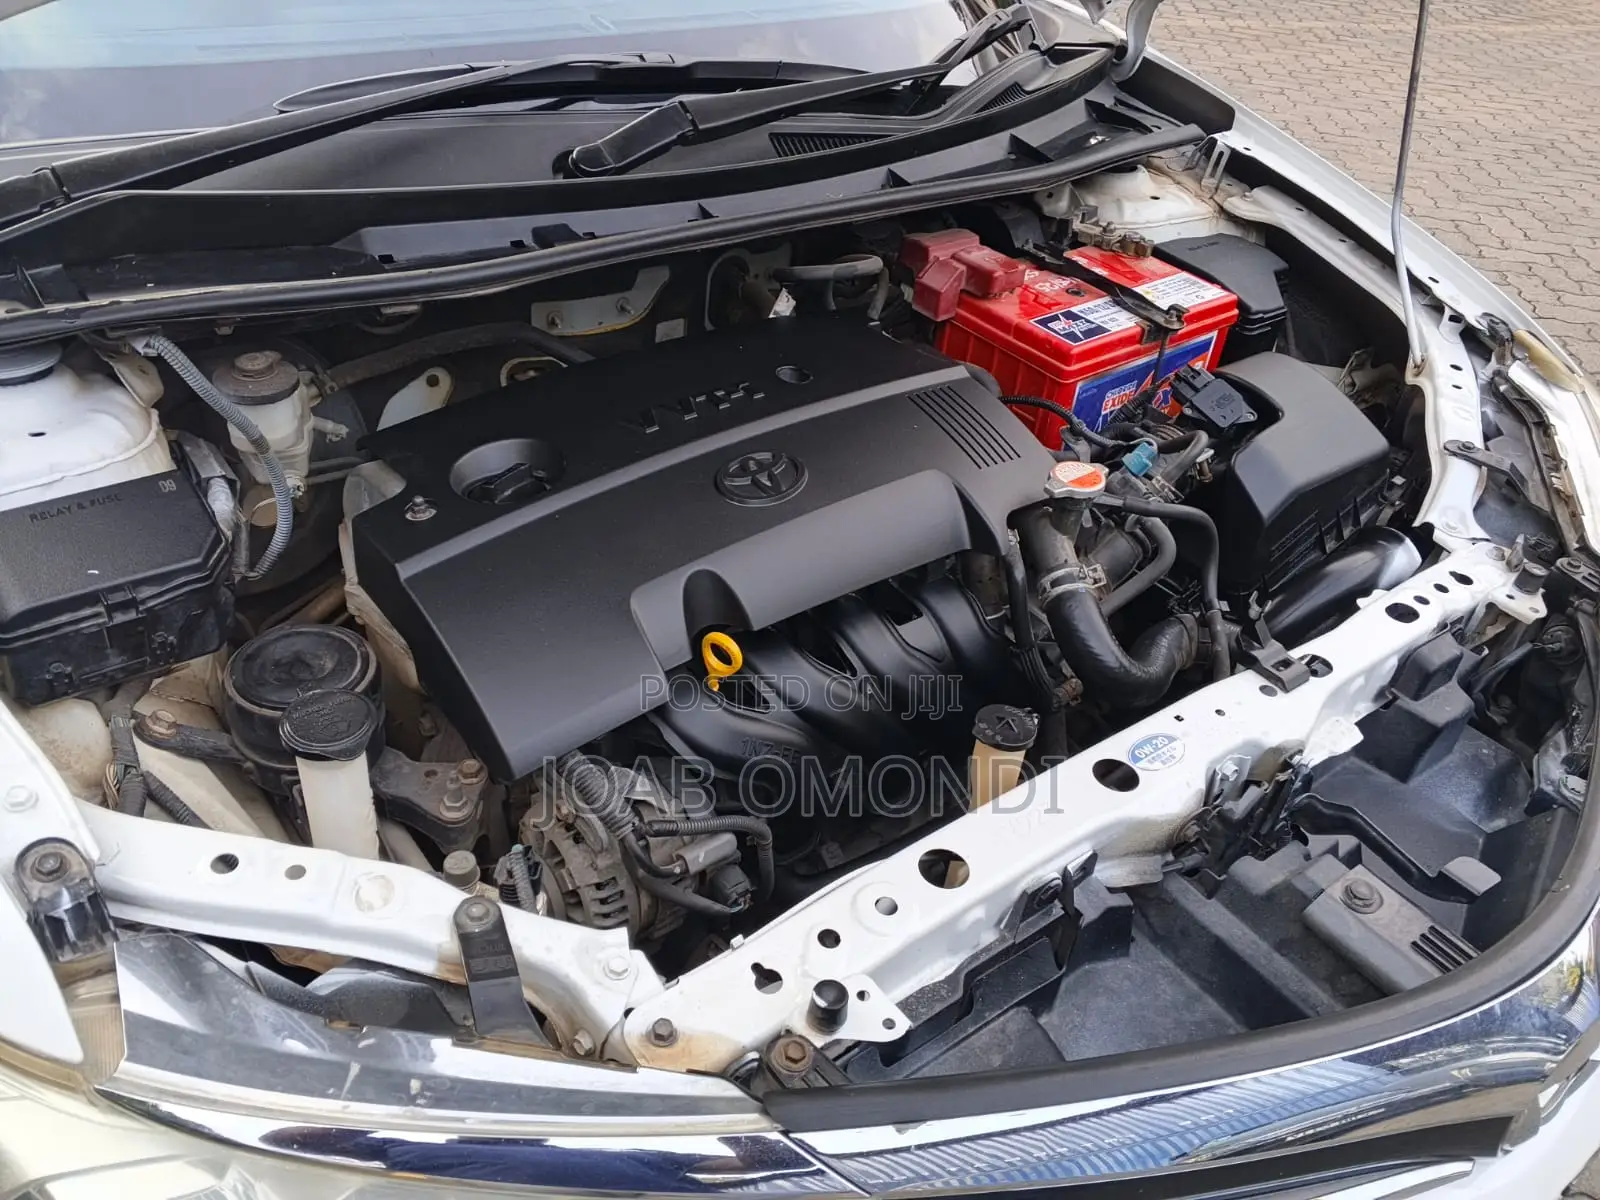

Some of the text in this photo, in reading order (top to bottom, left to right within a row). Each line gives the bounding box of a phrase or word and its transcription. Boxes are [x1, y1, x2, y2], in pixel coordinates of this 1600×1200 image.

[1102, 391, 1136, 412] EXIDE
[29, 492, 123, 524] RELAY & FUSE
